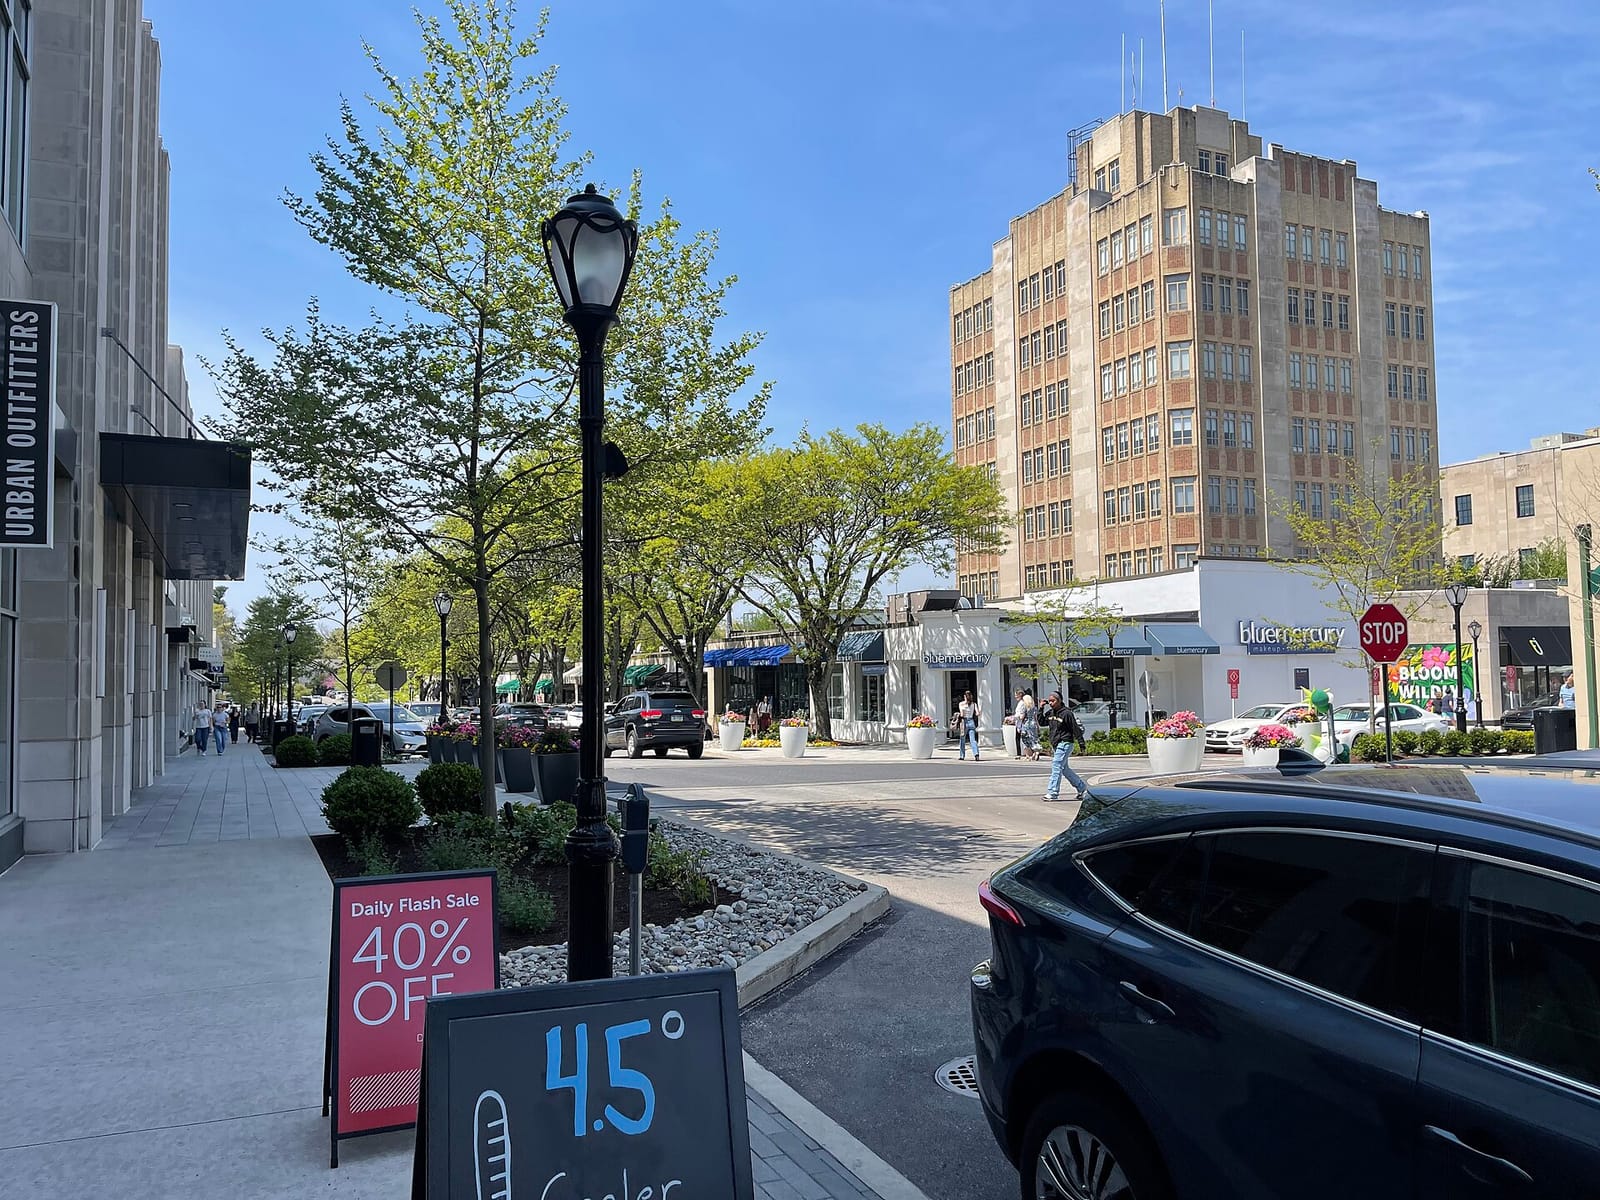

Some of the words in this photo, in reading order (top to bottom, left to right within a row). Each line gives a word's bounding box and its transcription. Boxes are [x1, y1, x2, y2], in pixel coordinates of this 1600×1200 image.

[6, 310, 39, 448] OUTFITTERS
[5, 459, 35, 536] URBAN
[1362, 621, 1405, 645] STOP
[922, 651, 992, 666] bluemercury
[1399, 665, 1458, 681] BLOOM
[351, 900, 393, 917] Daily
[399, 896, 441, 912] Flash
[446, 893, 480, 908] Sale
[352, 917, 471, 974] 40%
